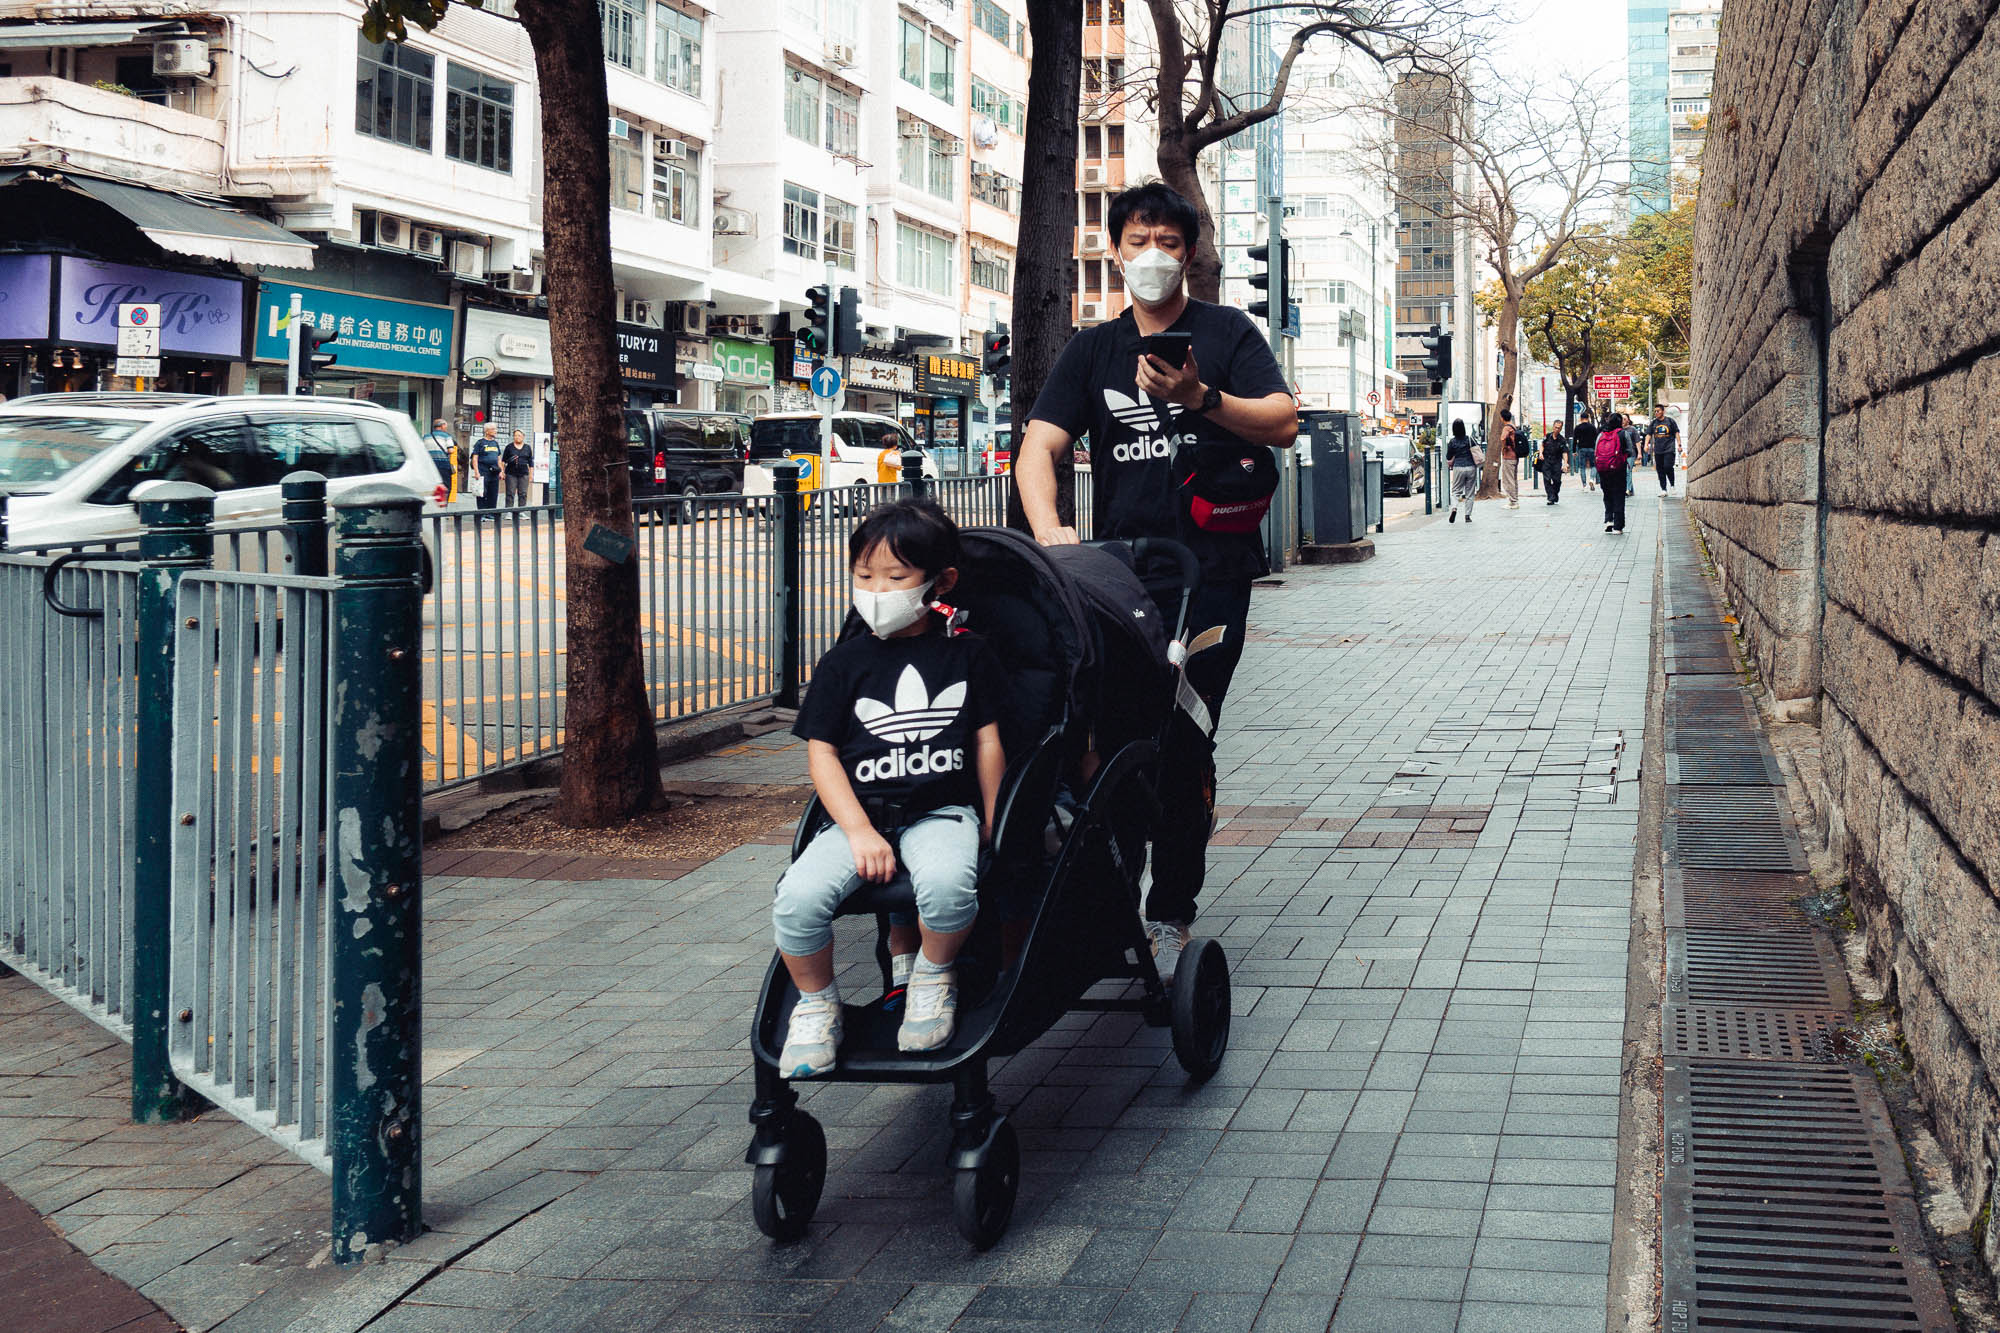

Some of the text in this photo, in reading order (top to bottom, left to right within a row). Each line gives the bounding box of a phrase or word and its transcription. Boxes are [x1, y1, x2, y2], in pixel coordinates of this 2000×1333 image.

[351, 338, 392, 351] INTEGRATED
[391, 343, 417, 354] MEDICAL
[417, 346, 441, 356] CENTRE
[616, 333, 647, 351] TURY
[648, 338, 658, 352] 21
[619, 354, 629, 363] ER
[713, 341, 774, 380] Soda
[1113, 433, 1198, 462] adids
[855, 744, 964, 783] adidas
